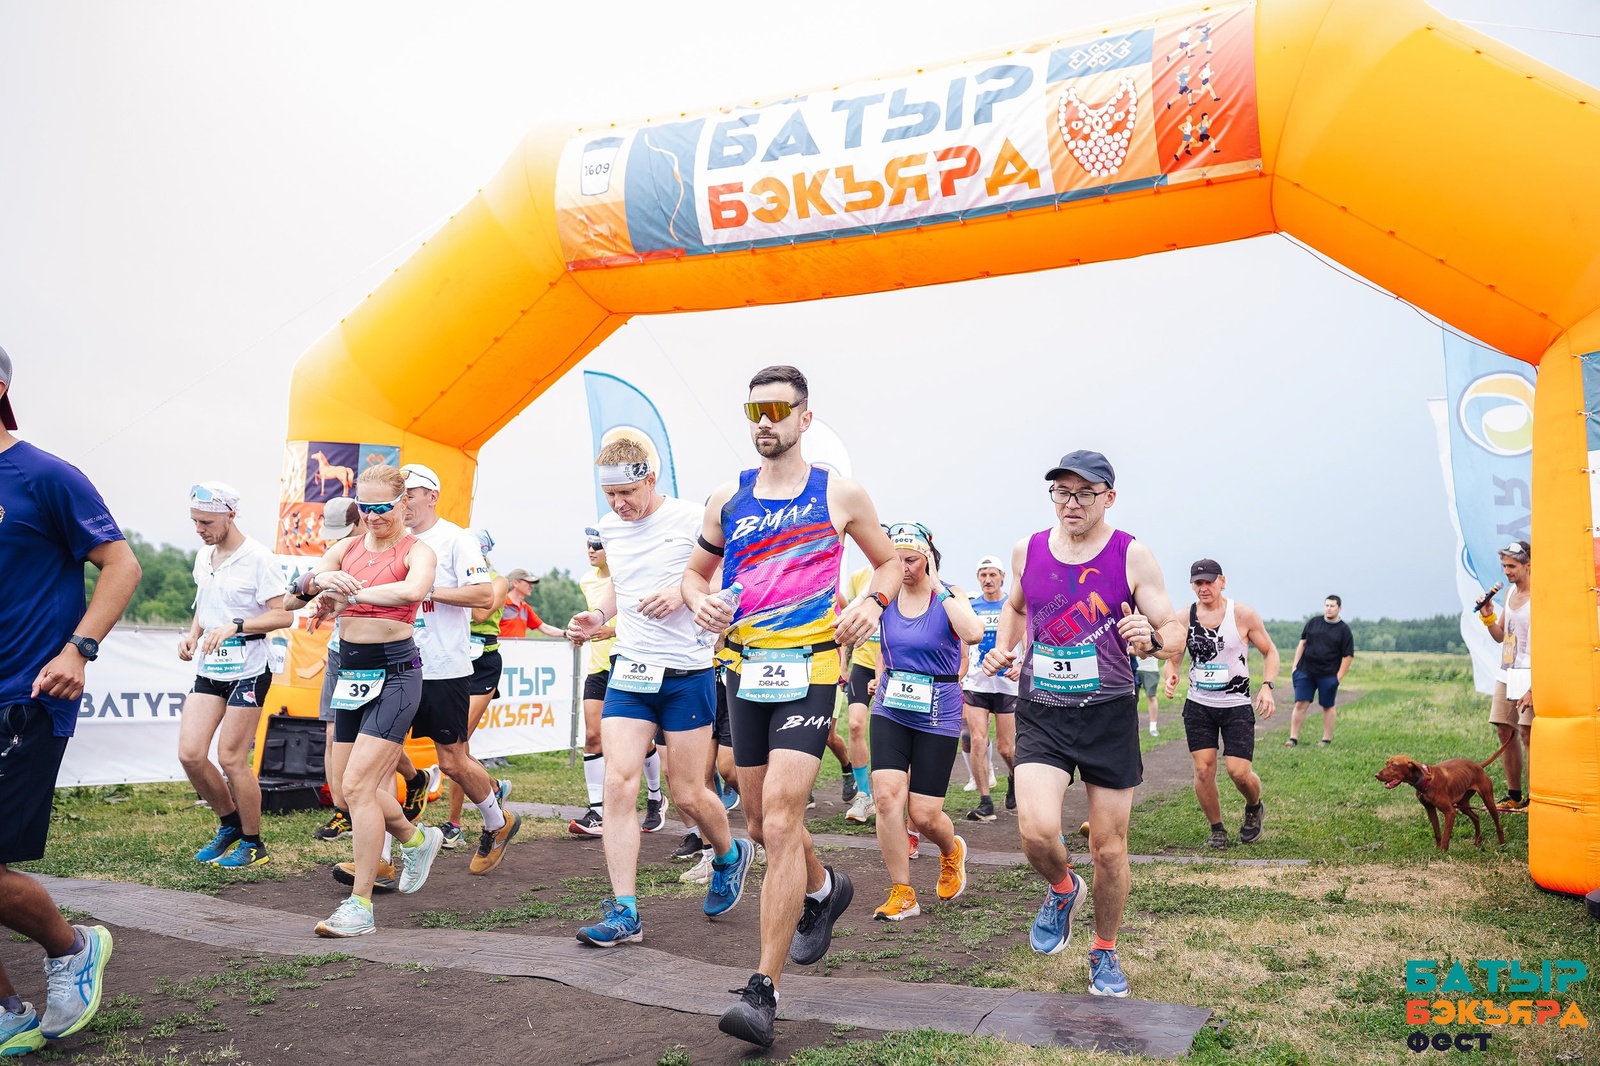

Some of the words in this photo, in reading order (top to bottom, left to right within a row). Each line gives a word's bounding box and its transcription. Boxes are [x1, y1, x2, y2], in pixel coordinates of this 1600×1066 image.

[707, 64, 1034, 170] БАТЫР
[584, 162, 610, 176] 1609
[707, 136, 1041, 230] БЭКЪЯРД
[986, 616, 999, 624] 36
[216, 648, 228, 657] 18
[630, 663, 647, 674] 20
[762, 665, 786, 678] 24
[1053, 661, 1072, 671] 31
[502, 667, 556, 697] ТЫР
[901, 683, 914, 693] 16
[349, 683, 370, 698] 39
[477, 703, 555, 730] ЭКЪЯРД
[776, 715, 832, 732] BMA
